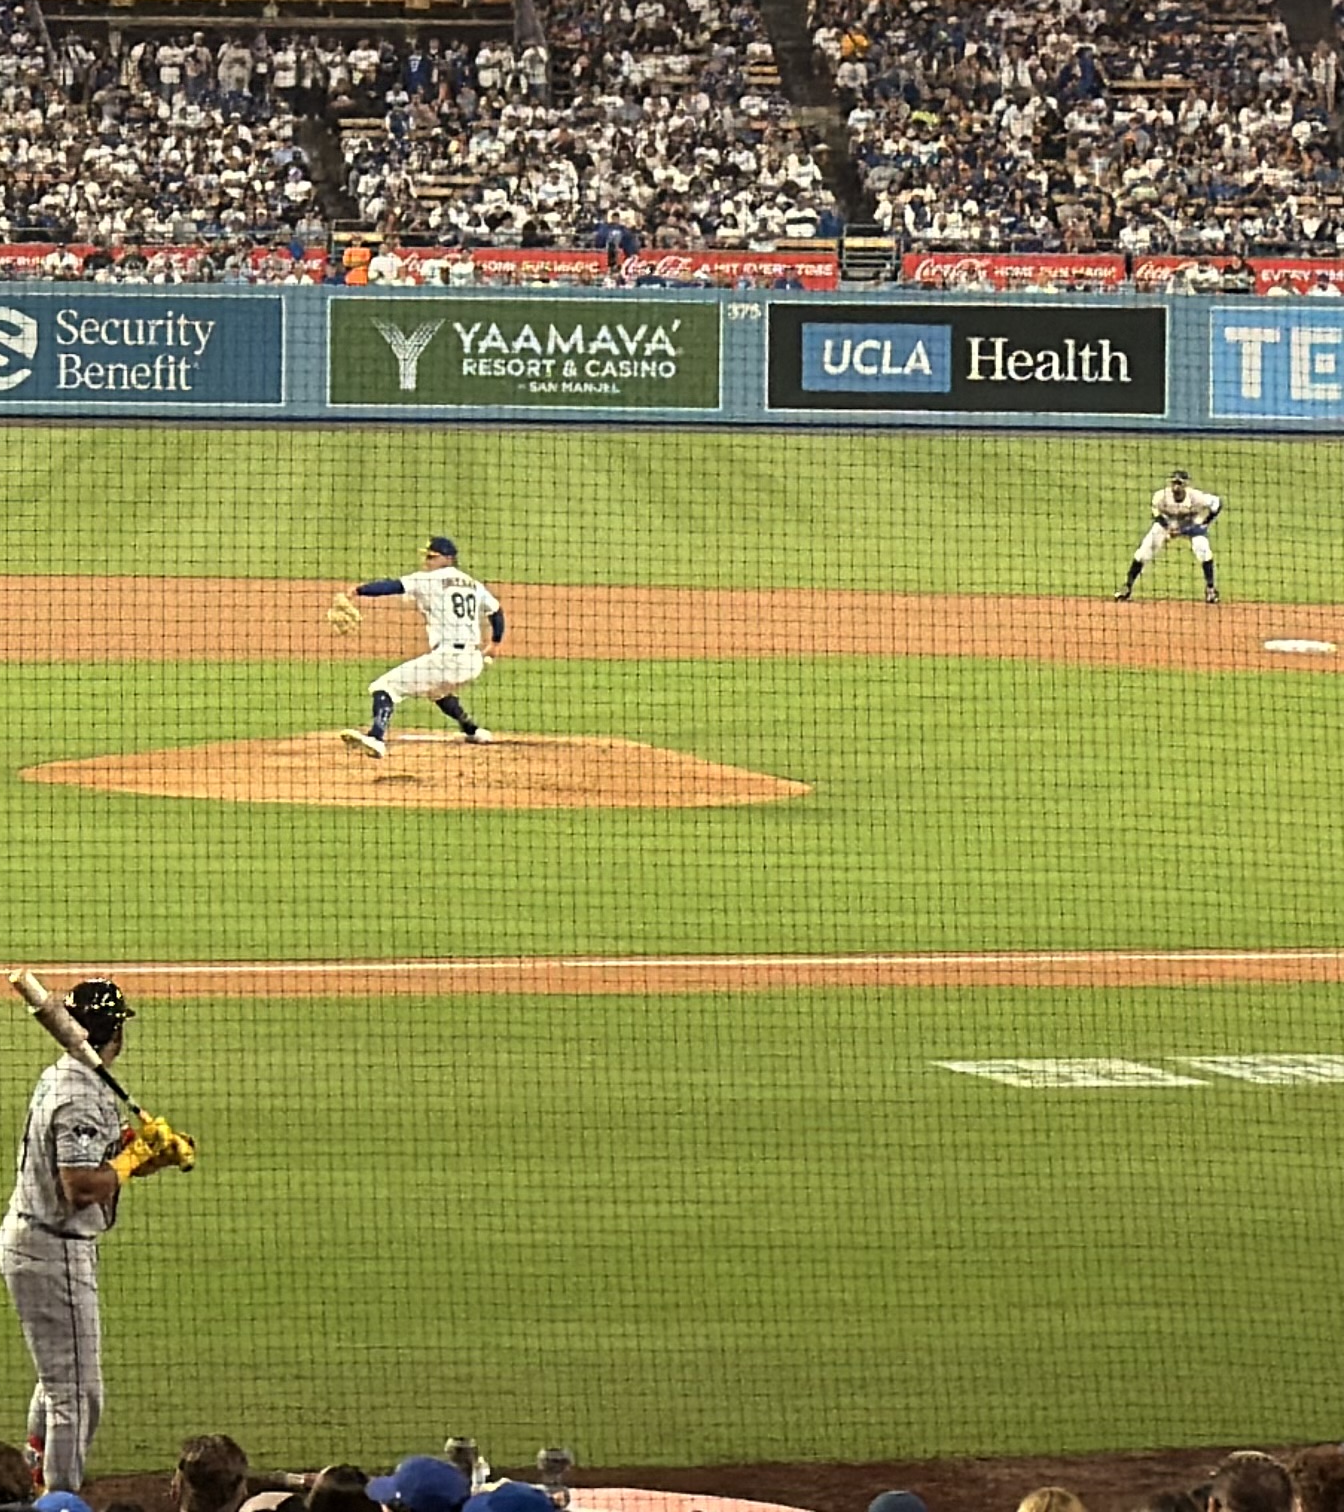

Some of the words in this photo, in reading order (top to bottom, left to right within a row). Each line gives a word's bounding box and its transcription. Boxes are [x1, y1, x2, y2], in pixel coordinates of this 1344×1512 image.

[714, 264, 738, 275] HIT
[797, 264, 833, 276] TIME
[56, 309, 216, 356] Security
[57, 353, 193, 391] Benefit
[462, 359, 555, 377] RESORT
[562, 359, 578, 377] &
[585, 360, 676, 379] CASINO
[823, 339, 932, 375] UCLA
[966, 337, 1131, 382] Health
[529, 382, 558, 393] SAN
[451, 591, 477, 621] 80
